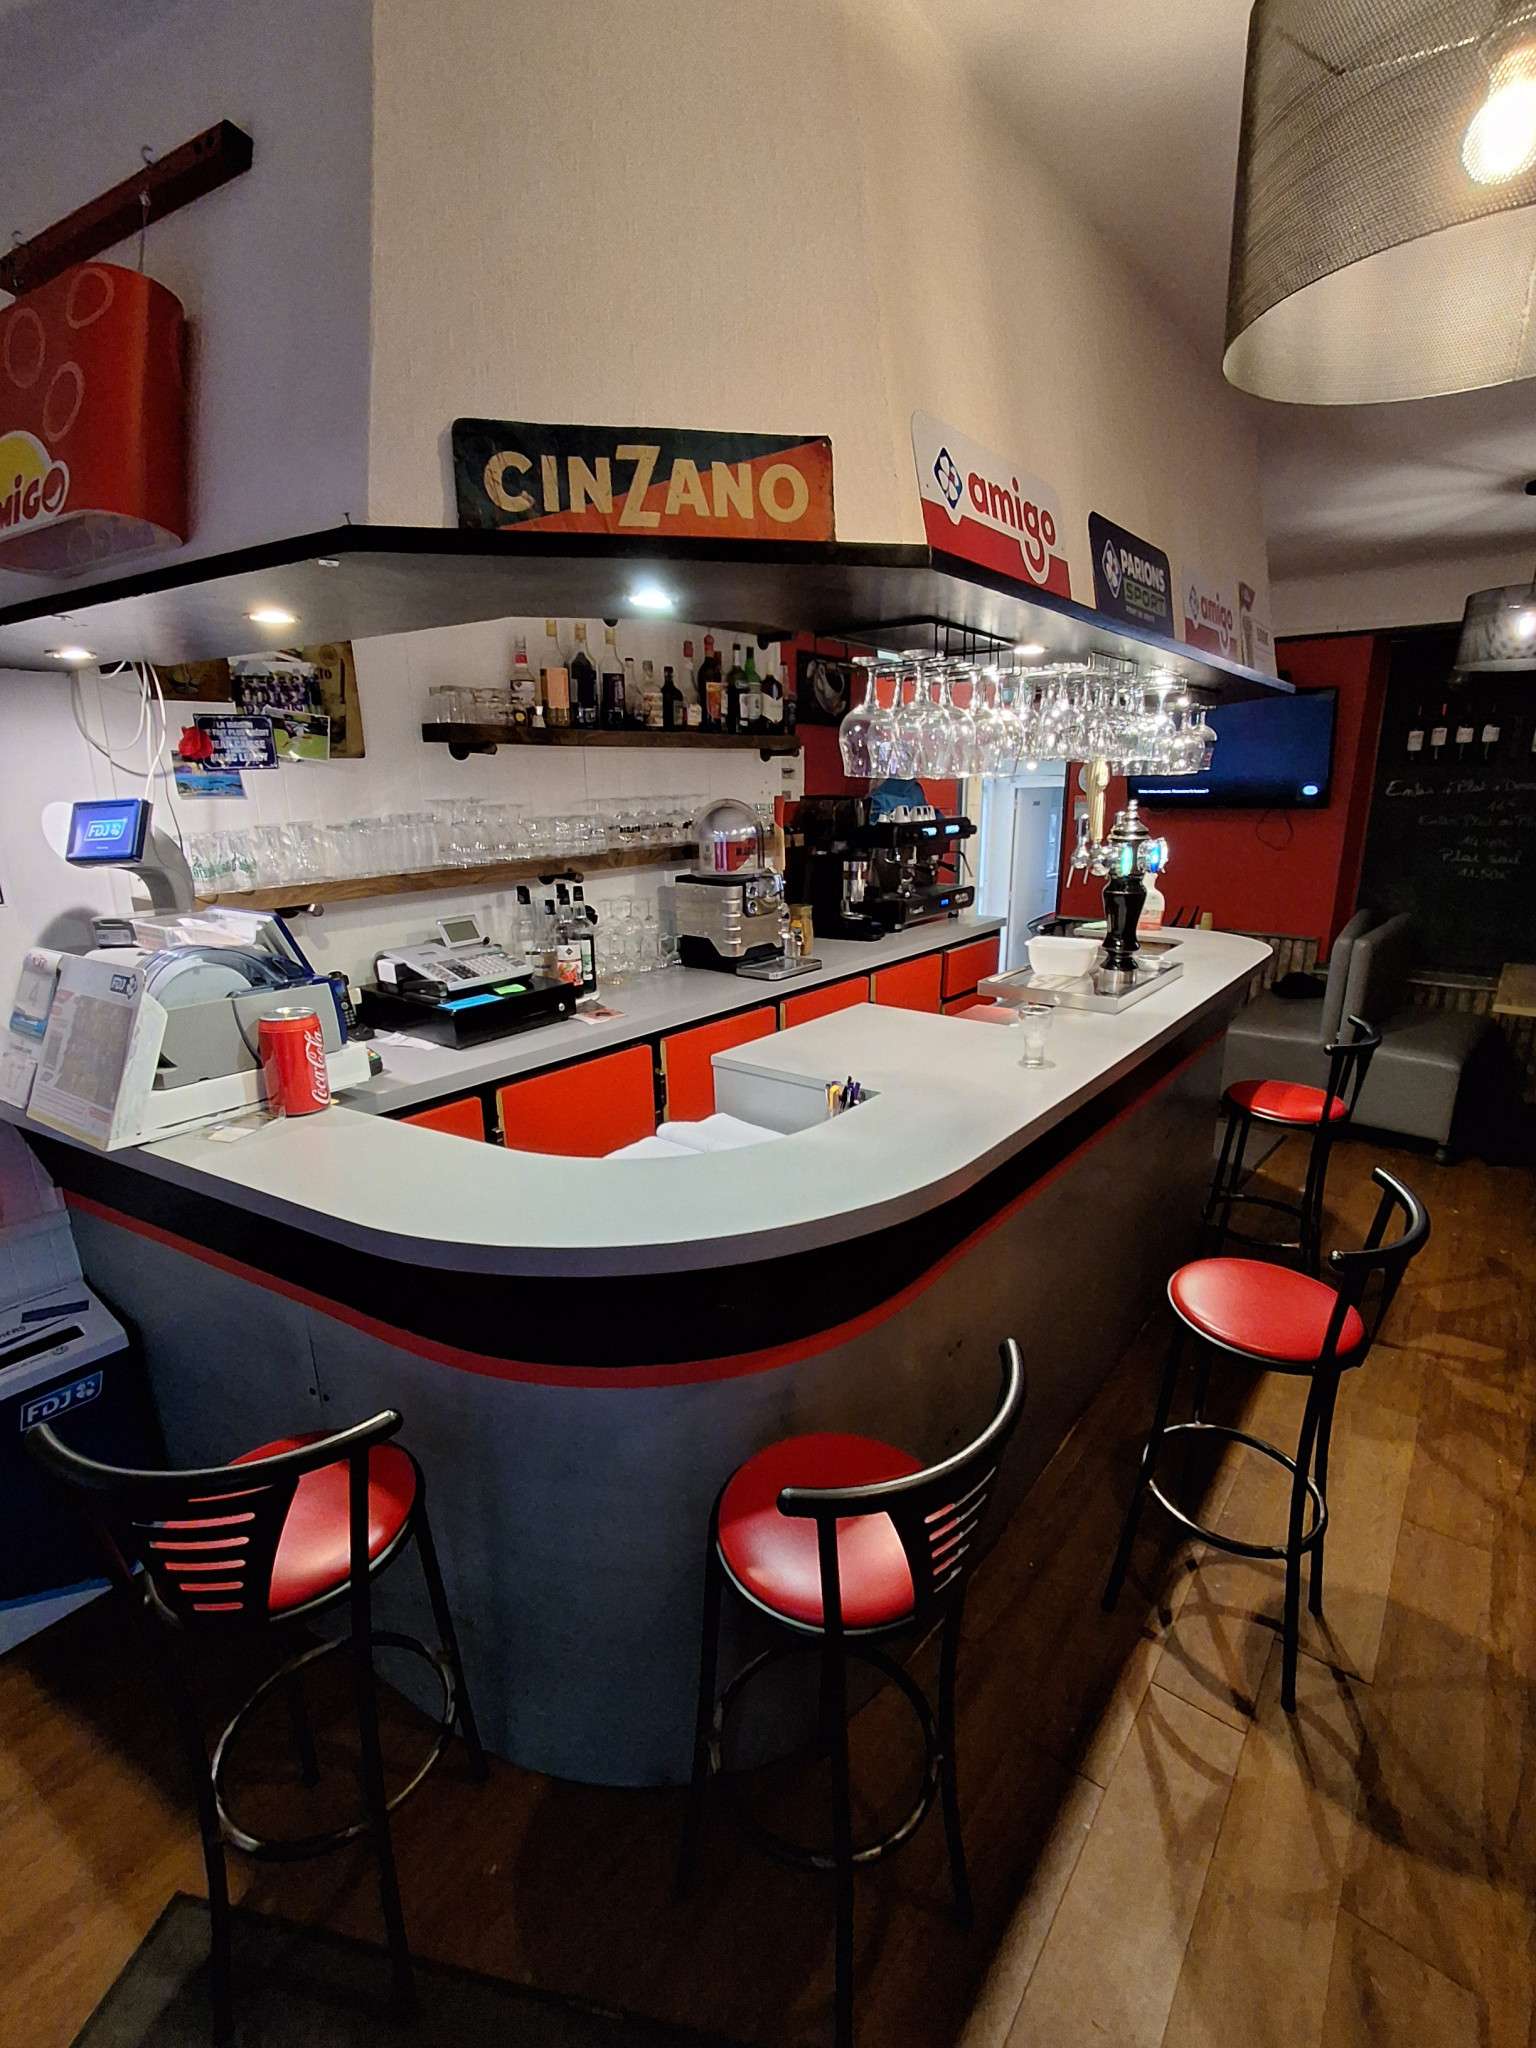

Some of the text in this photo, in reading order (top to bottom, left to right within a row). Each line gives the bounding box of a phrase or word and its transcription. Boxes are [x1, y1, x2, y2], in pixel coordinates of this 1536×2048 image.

[483, 444, 810, 528] CINZANO
[967, 472, 1056, 573] amigo
[1120, 548, 1166, 592] PARIONS
[1125, 581, 1167, 613] SPORT
[1201, 592, 1233, 650] amigo
[88, 824, 110, 837] FDJ
[27, 1390, 72, 1423] FDJ
